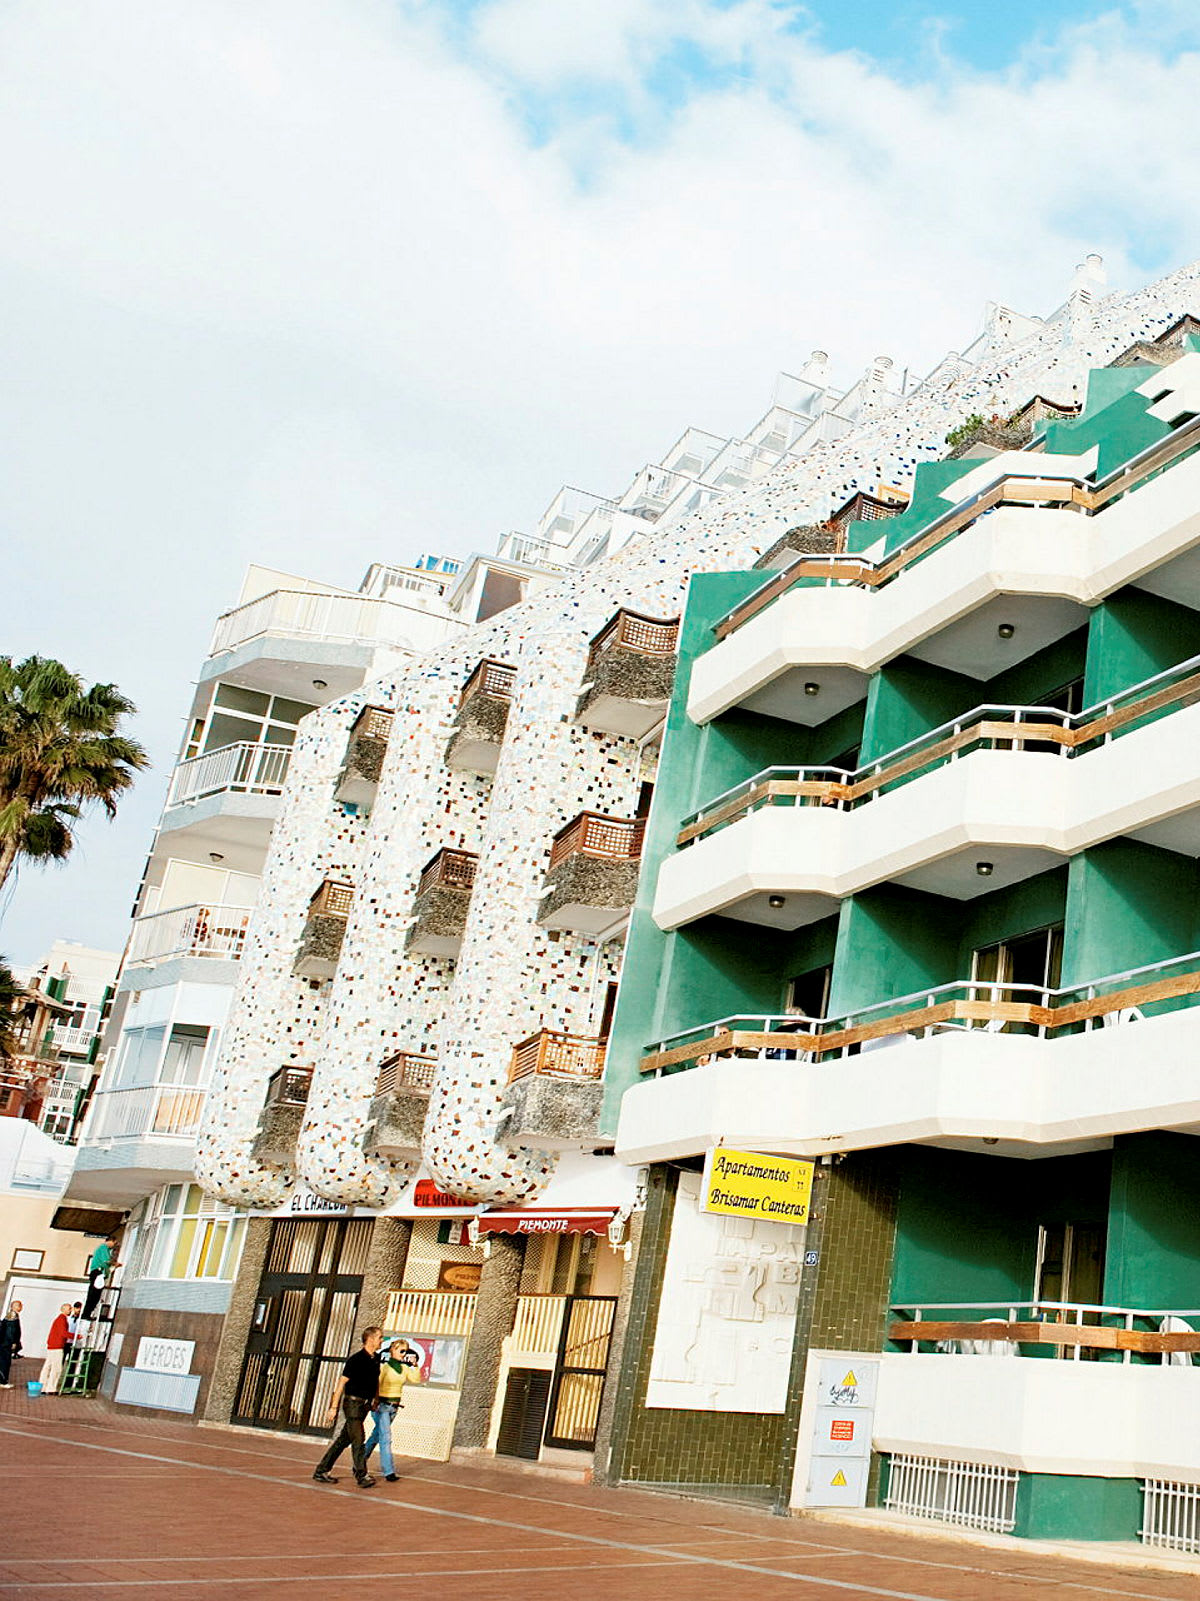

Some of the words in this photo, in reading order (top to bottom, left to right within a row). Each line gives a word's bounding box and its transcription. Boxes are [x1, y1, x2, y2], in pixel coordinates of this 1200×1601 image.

[714, 1156, 791, 1183] Apartamentos
[291, 1194, 301, 1211] EL
[710, 1188, 760, 1210] Brisamar
[761, 1196, 806, 1217] Canteras
[518, 1219, 569, 1230] PIEMONTE
[143, 1343, 187, 1369] VERDES
